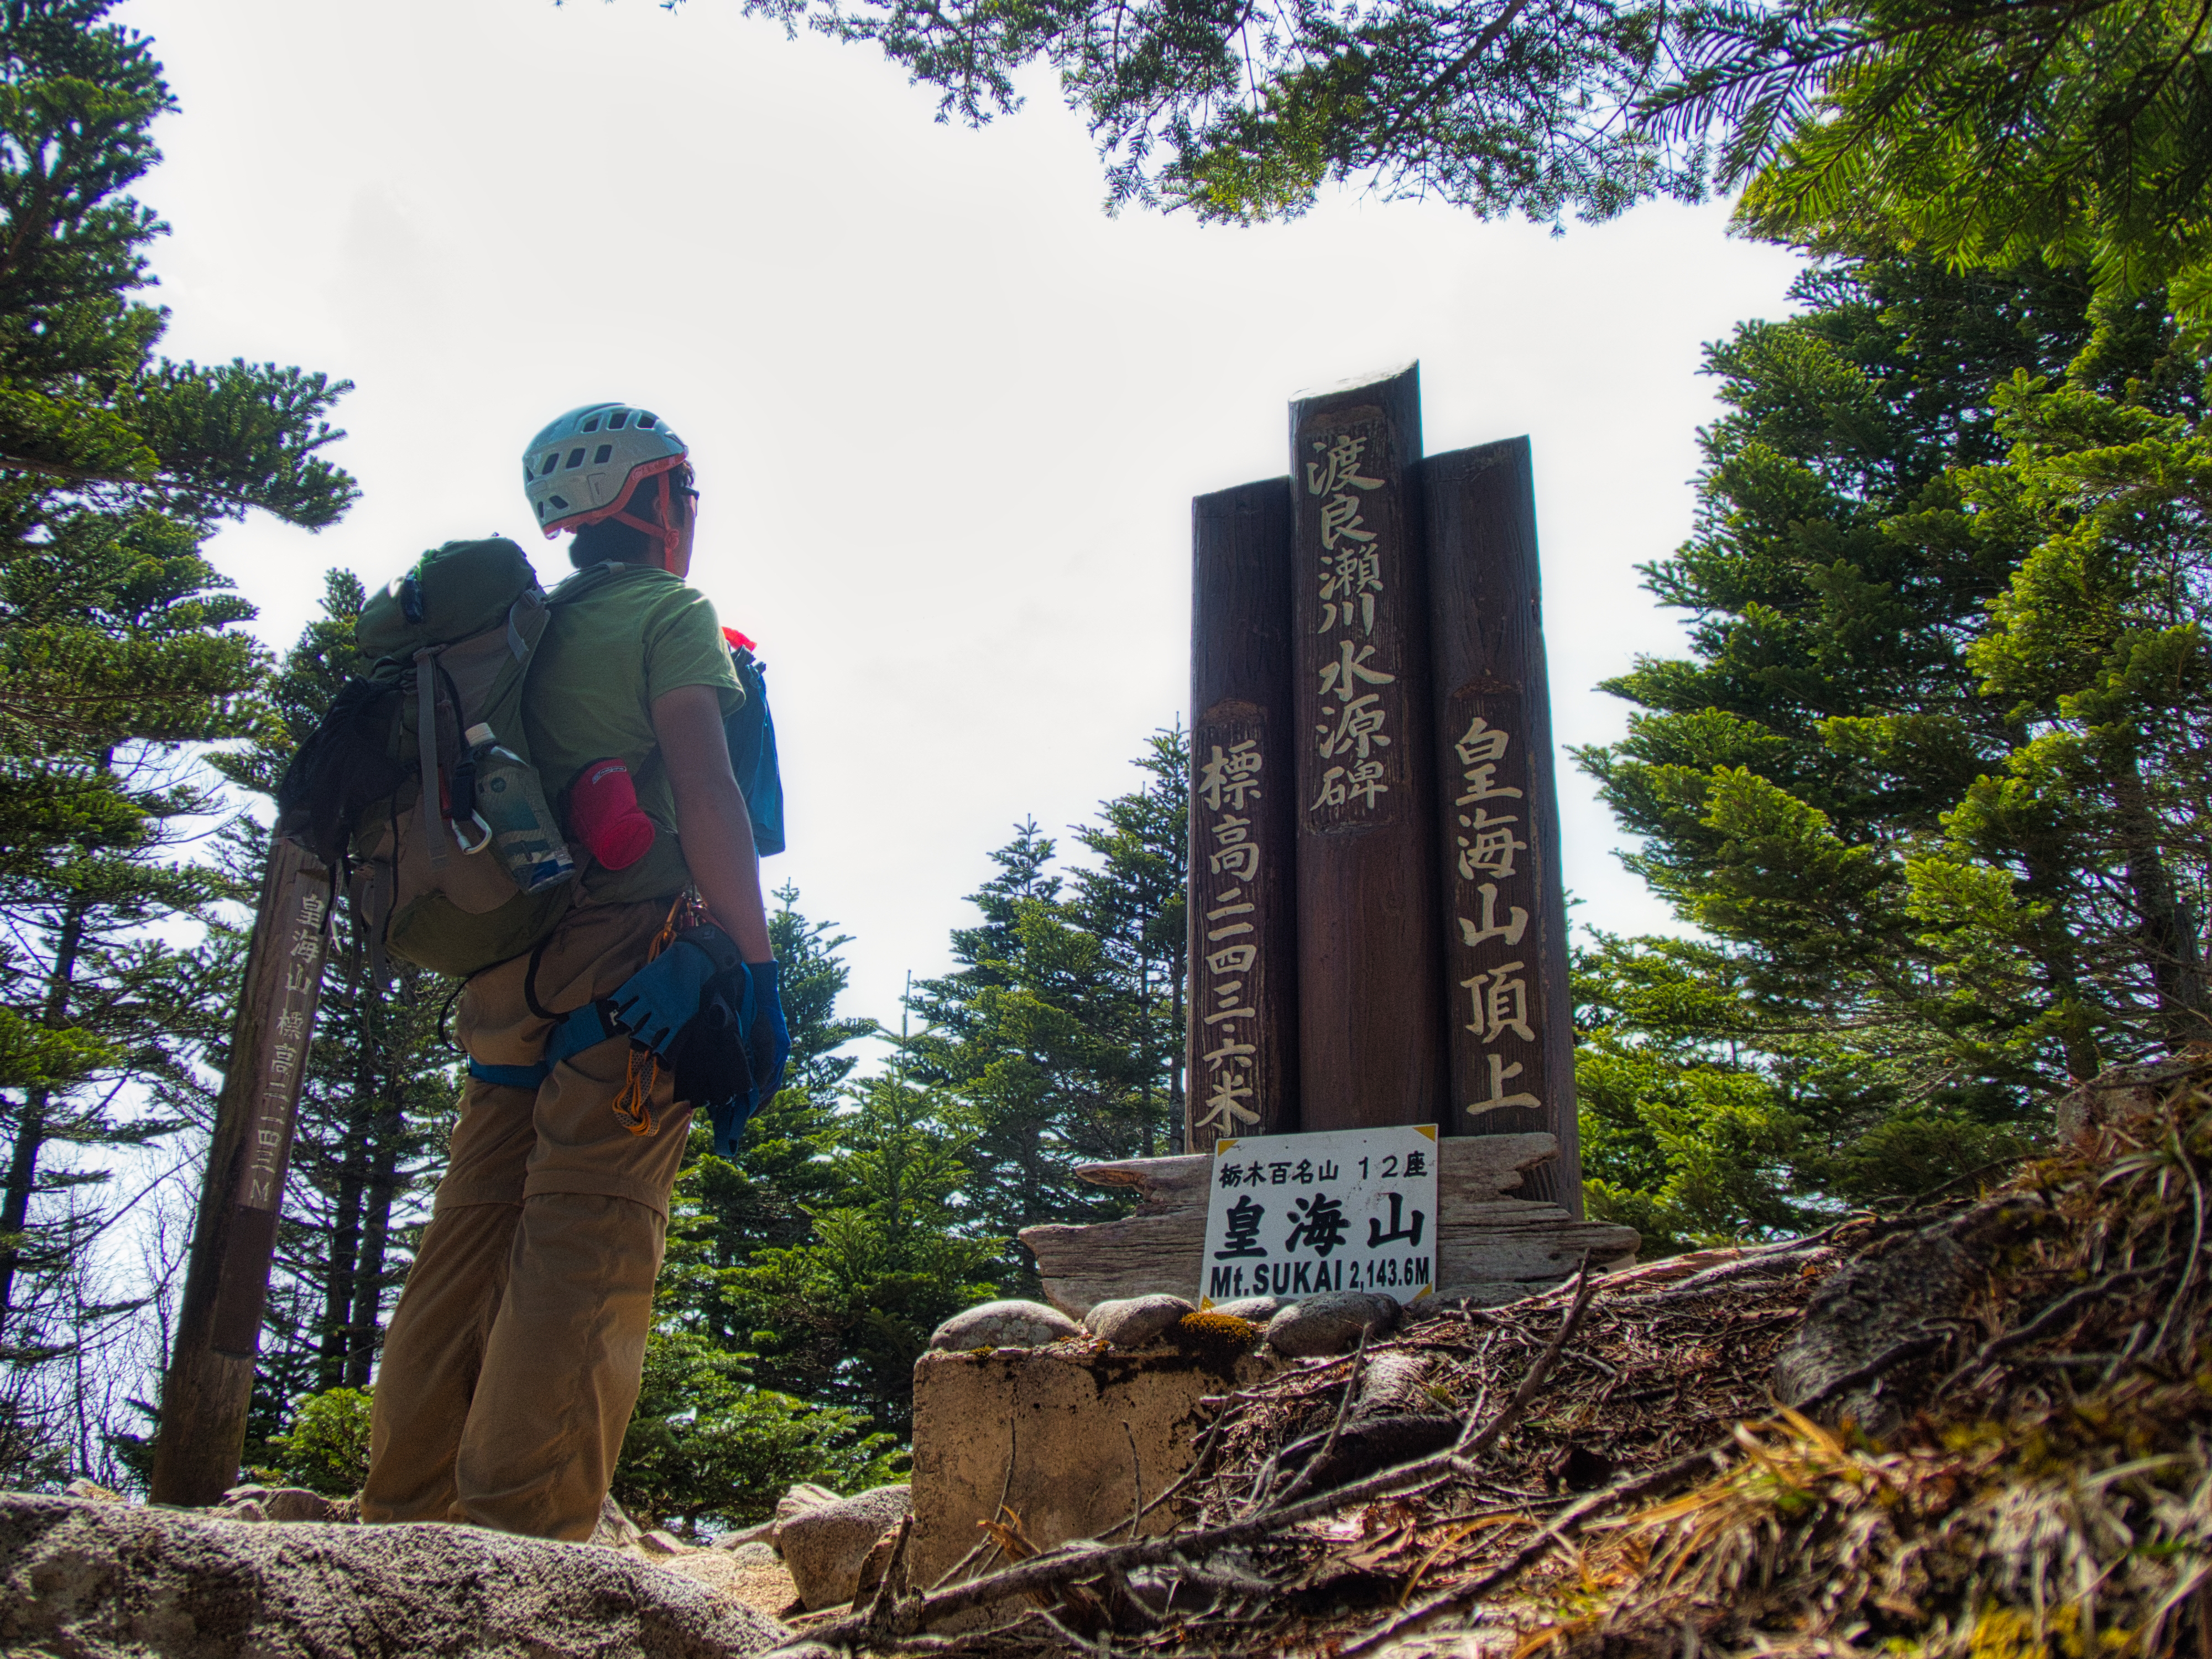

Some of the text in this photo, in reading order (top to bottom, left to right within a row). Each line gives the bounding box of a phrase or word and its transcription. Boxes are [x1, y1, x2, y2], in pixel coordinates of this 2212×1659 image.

[1455, 717, 1541, 1115] 皇海山頂上
[1219, 1159, 1339, 1189] 栃木百名山
[1214, 1192, 1426, 1261] 皇海山
[1209, 1256, 1430, 1299] Mt.SUKAI 2,143.6M
